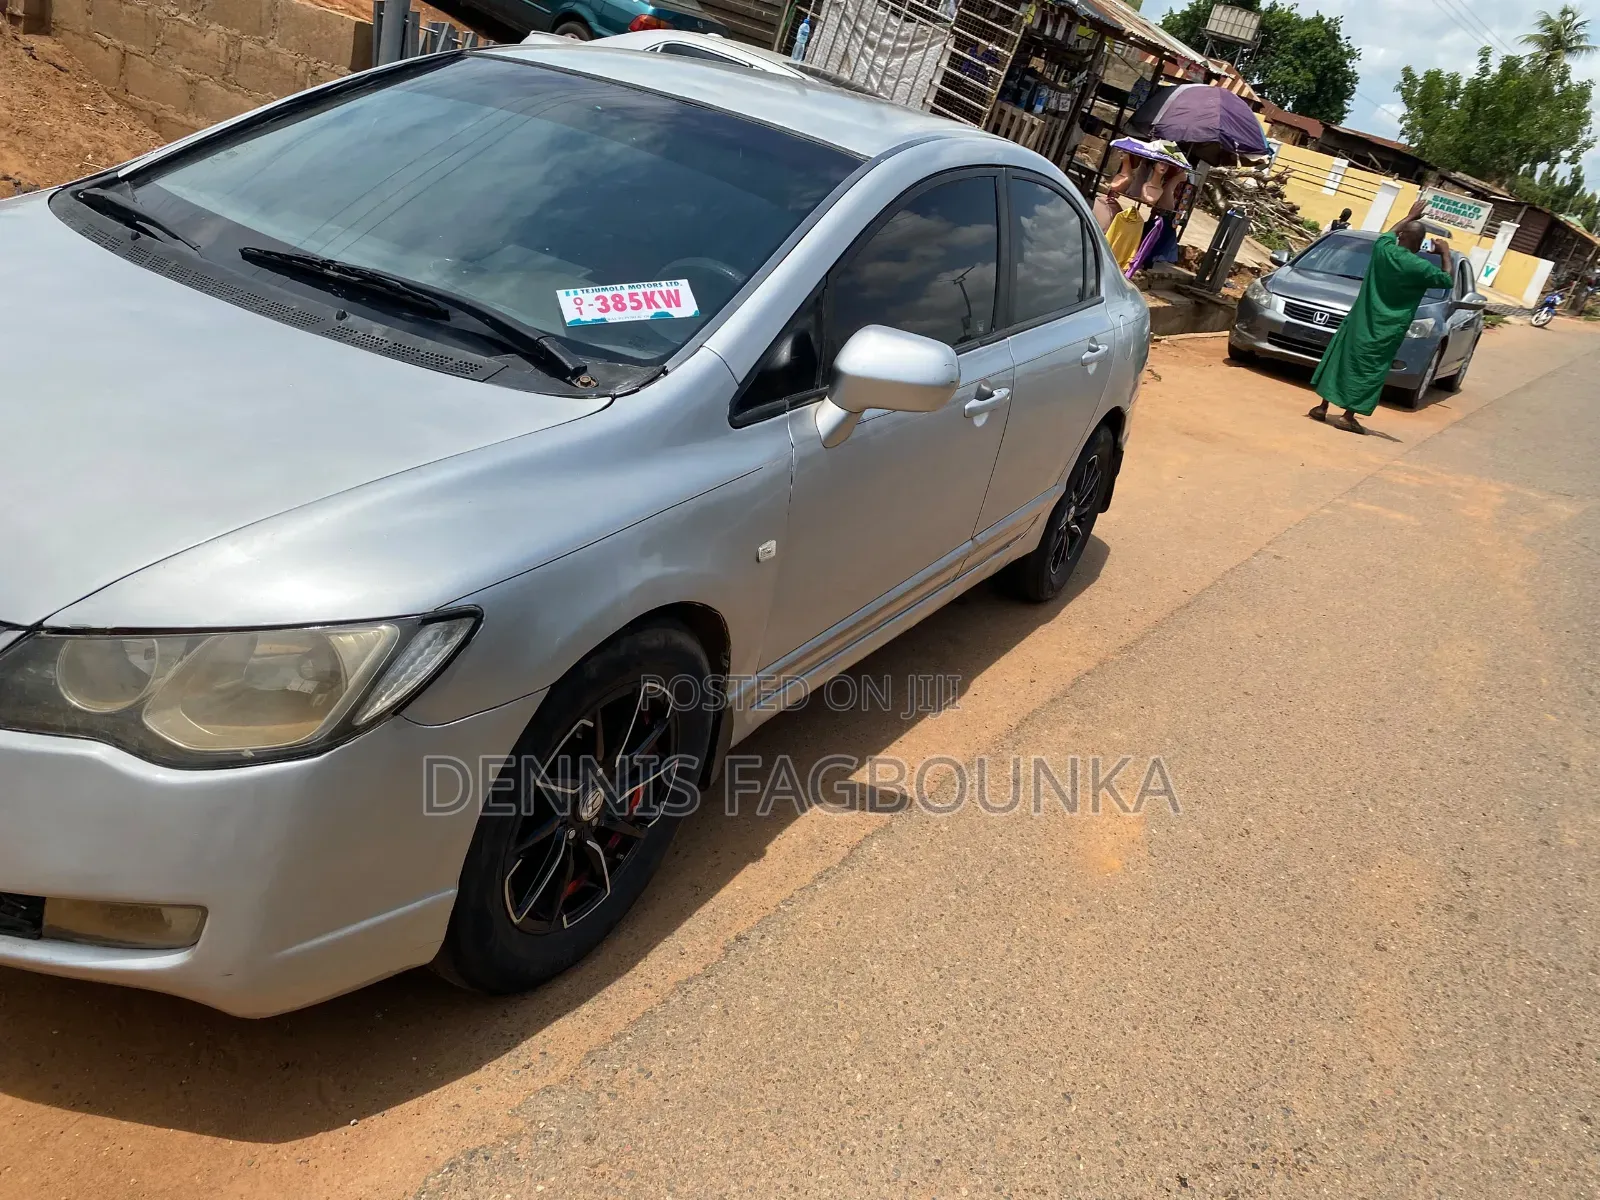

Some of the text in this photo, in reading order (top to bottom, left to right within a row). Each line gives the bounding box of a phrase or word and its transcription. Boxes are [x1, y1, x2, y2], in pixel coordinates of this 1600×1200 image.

[1427, 200, 1482, 220] PHARMACY
[1432, 195, 1481, 213] SHEKAYO
[580, 285, 625, 294] TEJUMOLA
[627, 281, 663, 290] MOTORS
